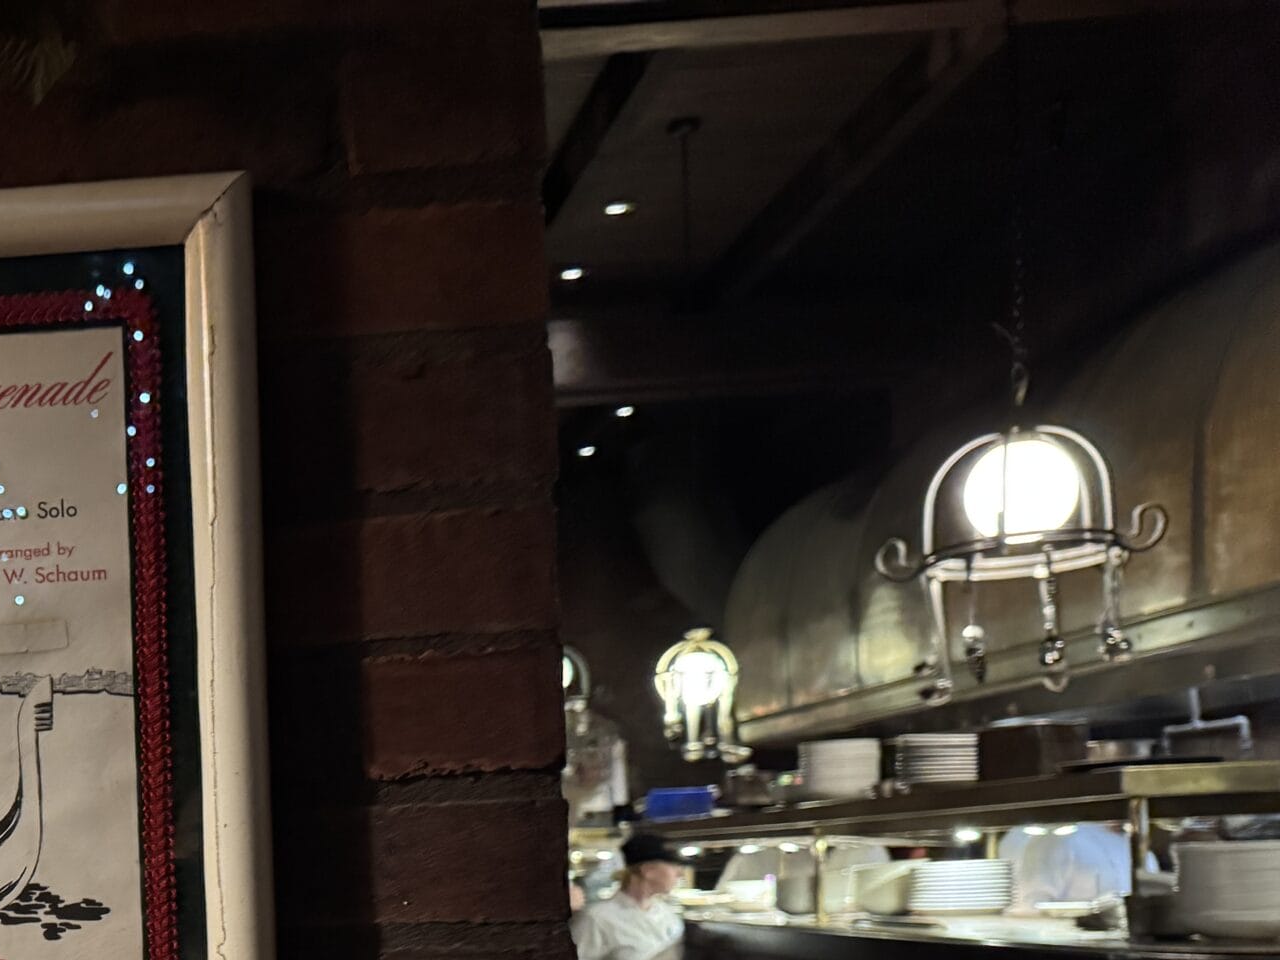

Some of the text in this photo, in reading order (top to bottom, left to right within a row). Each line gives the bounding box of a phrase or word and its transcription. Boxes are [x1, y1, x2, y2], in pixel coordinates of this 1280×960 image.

[37, 498, 77, 519] Solo
[57, 541, 75, 557] by
[3, 568, 28, 585] W.
[35, 564, 108, 584] Schaum
